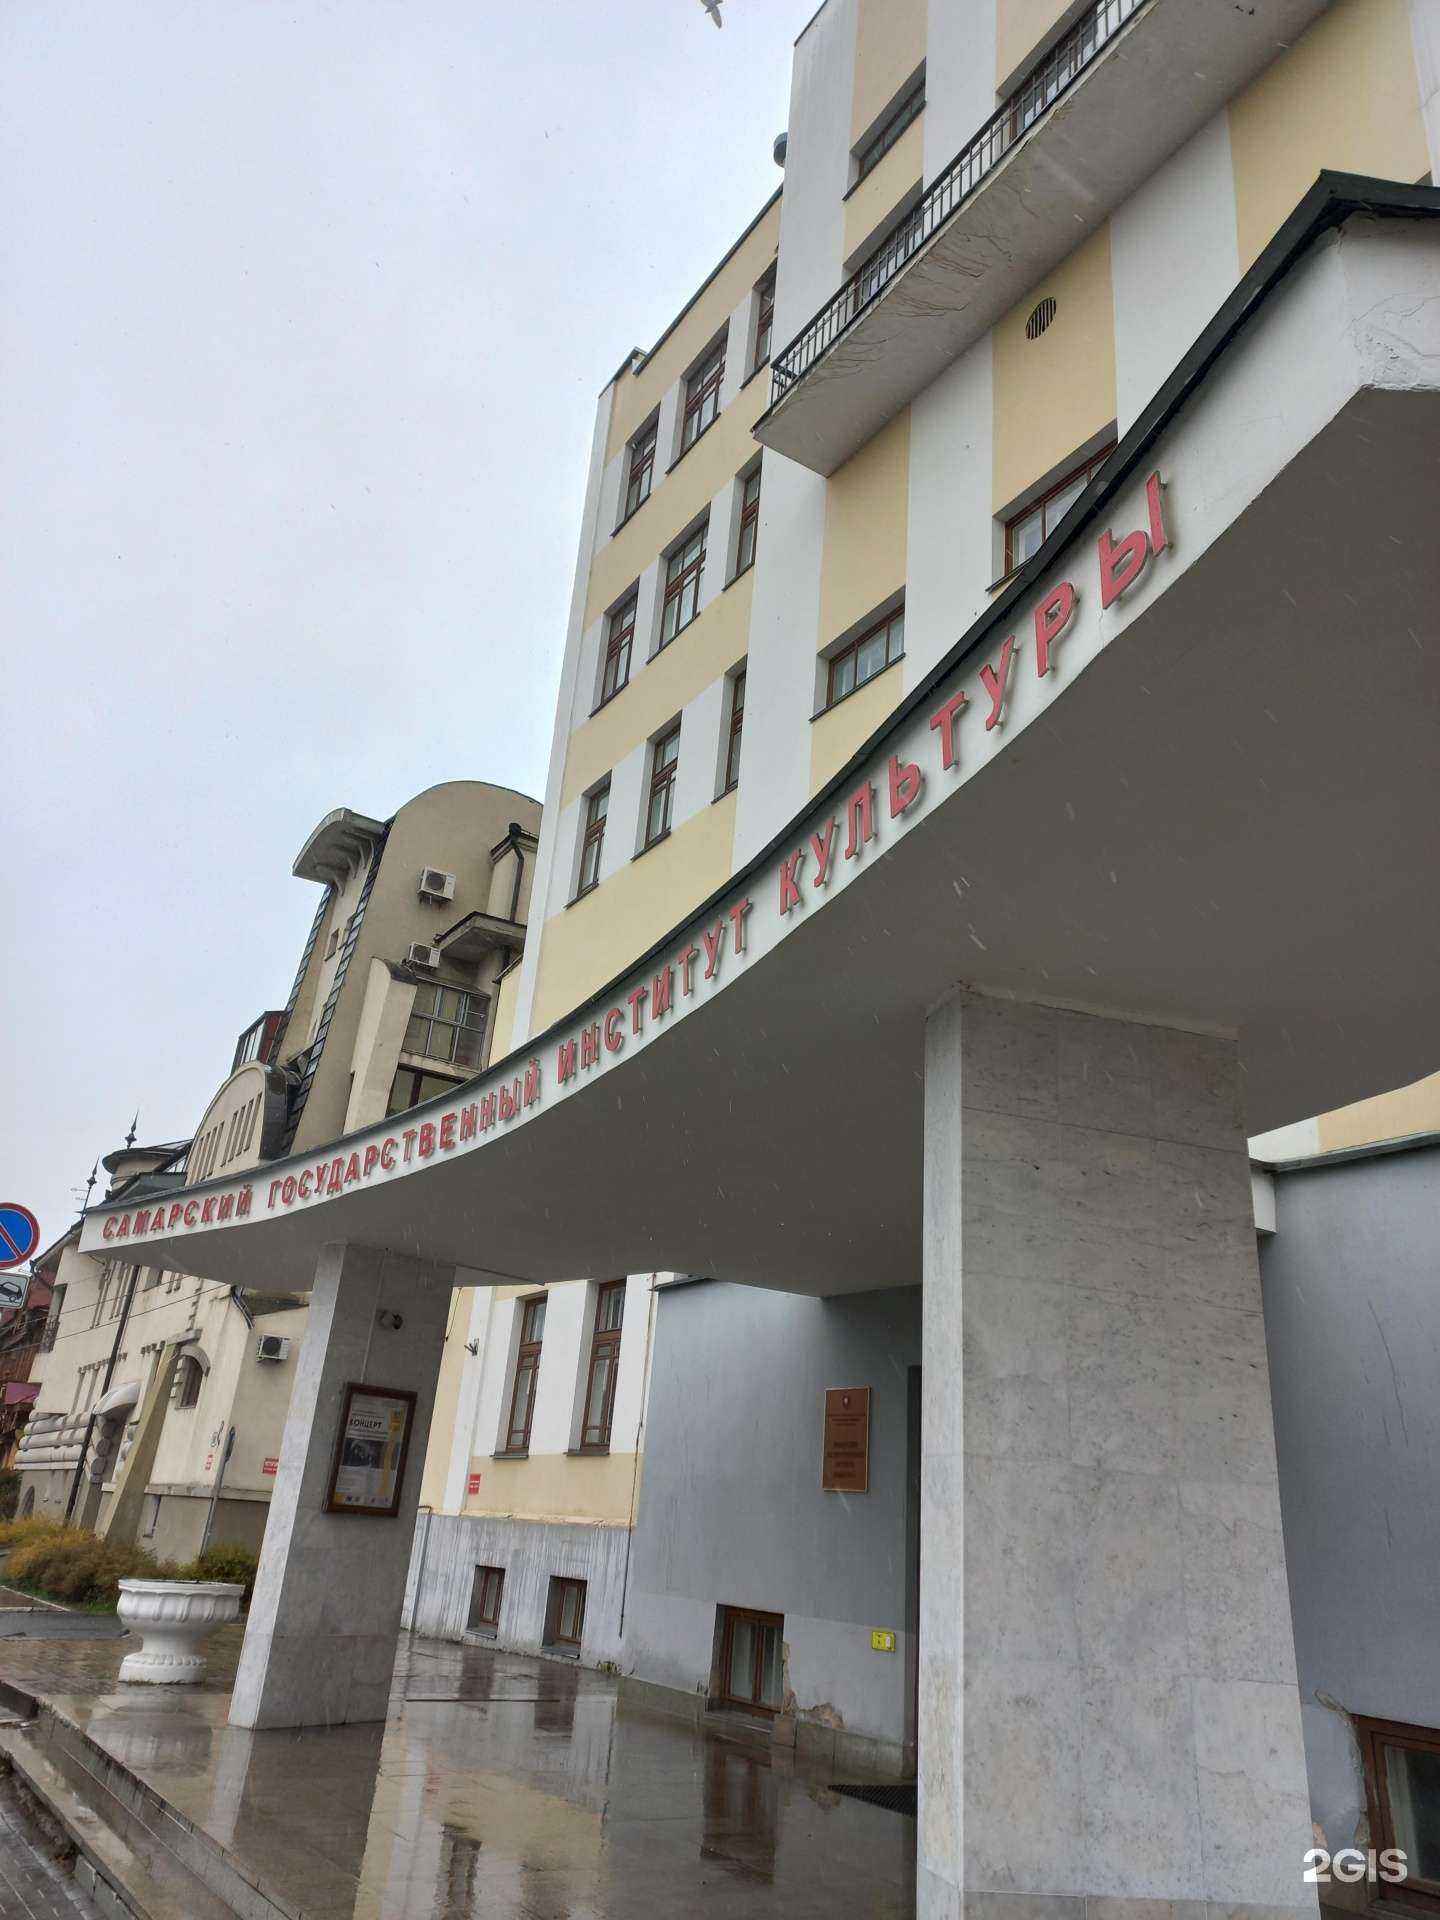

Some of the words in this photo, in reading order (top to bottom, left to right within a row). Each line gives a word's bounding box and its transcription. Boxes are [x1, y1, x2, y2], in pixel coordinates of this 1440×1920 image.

[102, 1184, 253, 1240] САМАРСКИЙ
[267, 1057, 542, 1209] ГОСУДАРСТВЕННЫЙ
[557, 898, 752, 1084] ИНСТИТУТ
[779, 470, 1169, 916] КУЛЬТУРЫ
